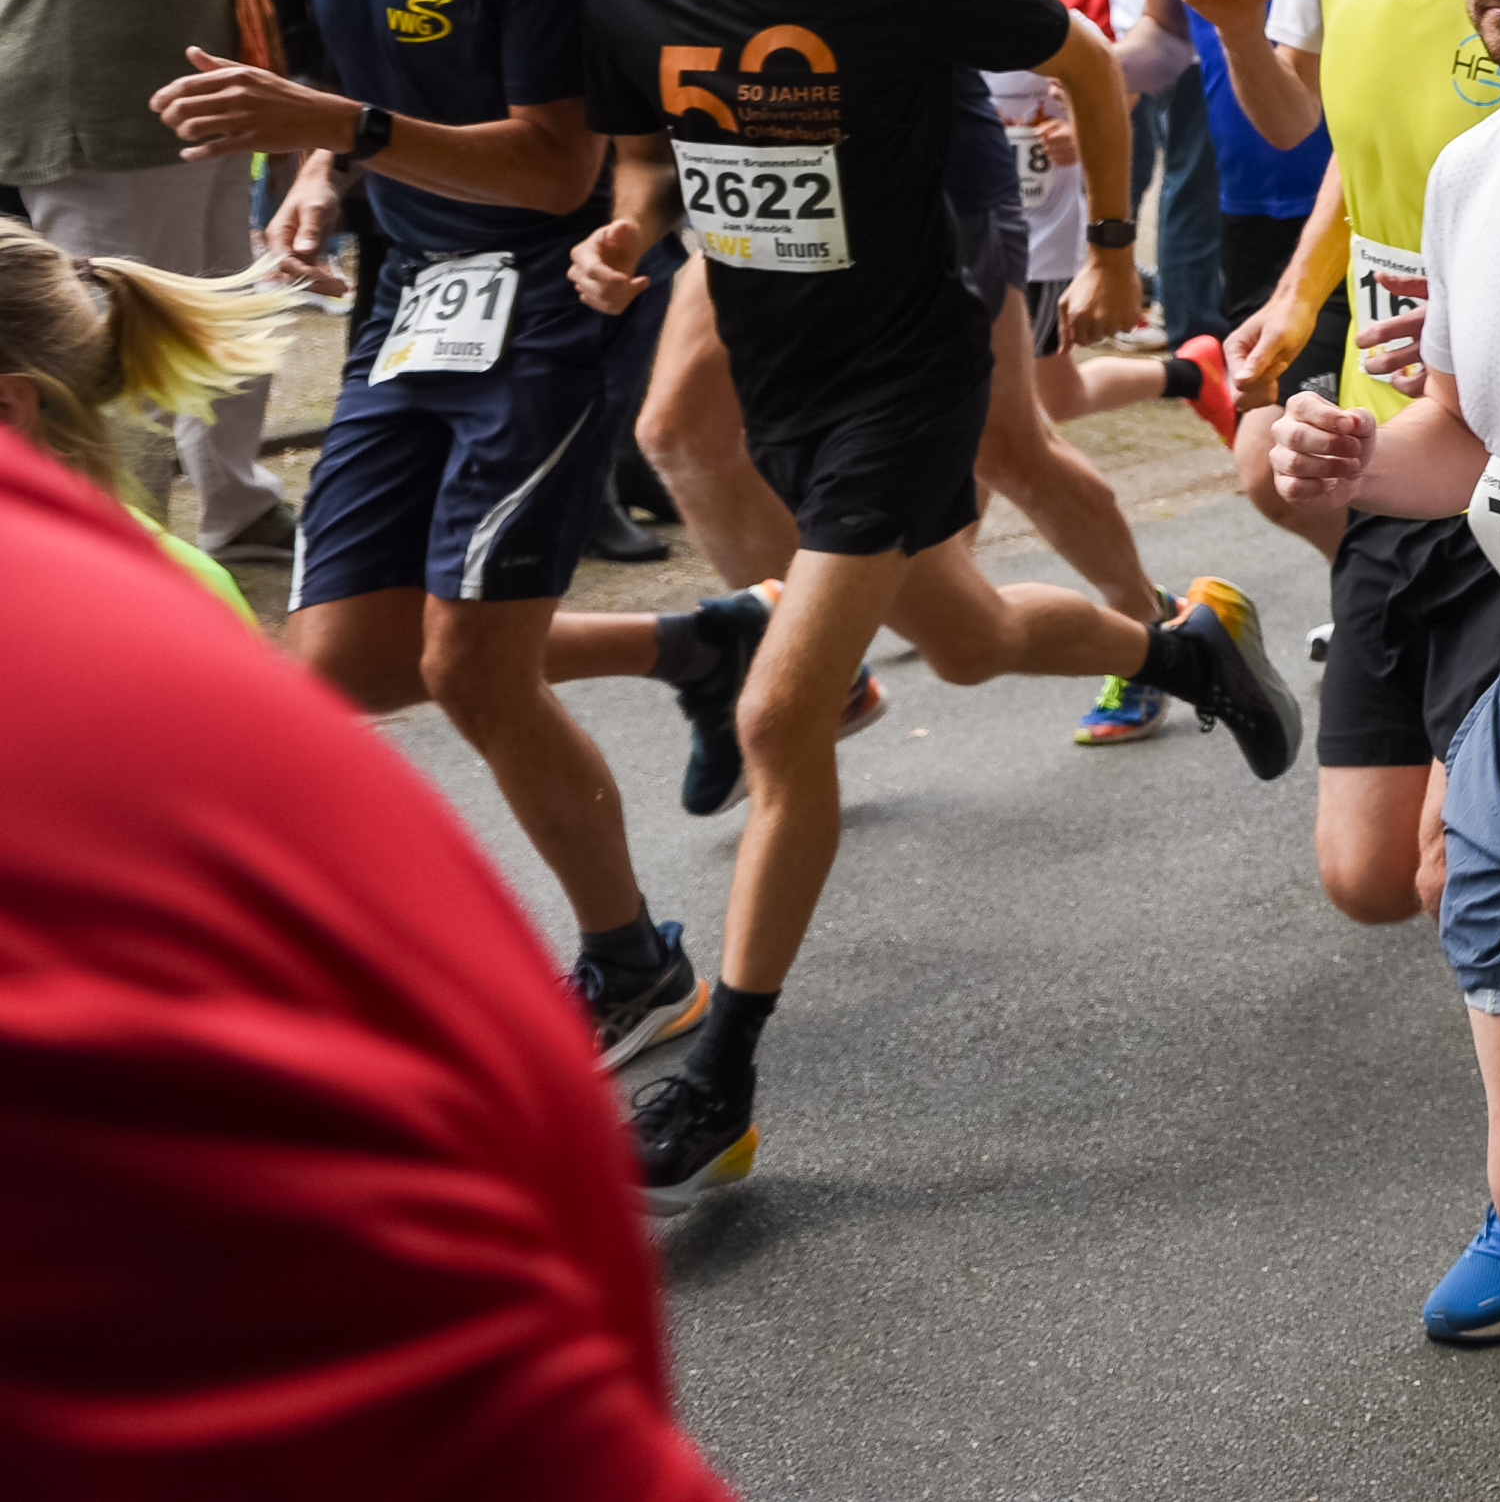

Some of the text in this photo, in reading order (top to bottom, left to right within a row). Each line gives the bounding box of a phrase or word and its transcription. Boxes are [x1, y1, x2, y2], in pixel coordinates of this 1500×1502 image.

[737, 84, 841, 102] 50 JAHRE
[684, 167, 836, 220] 2622
[705, 231, 752, 258] EWE
[774, 237, 830, 258] bruns
